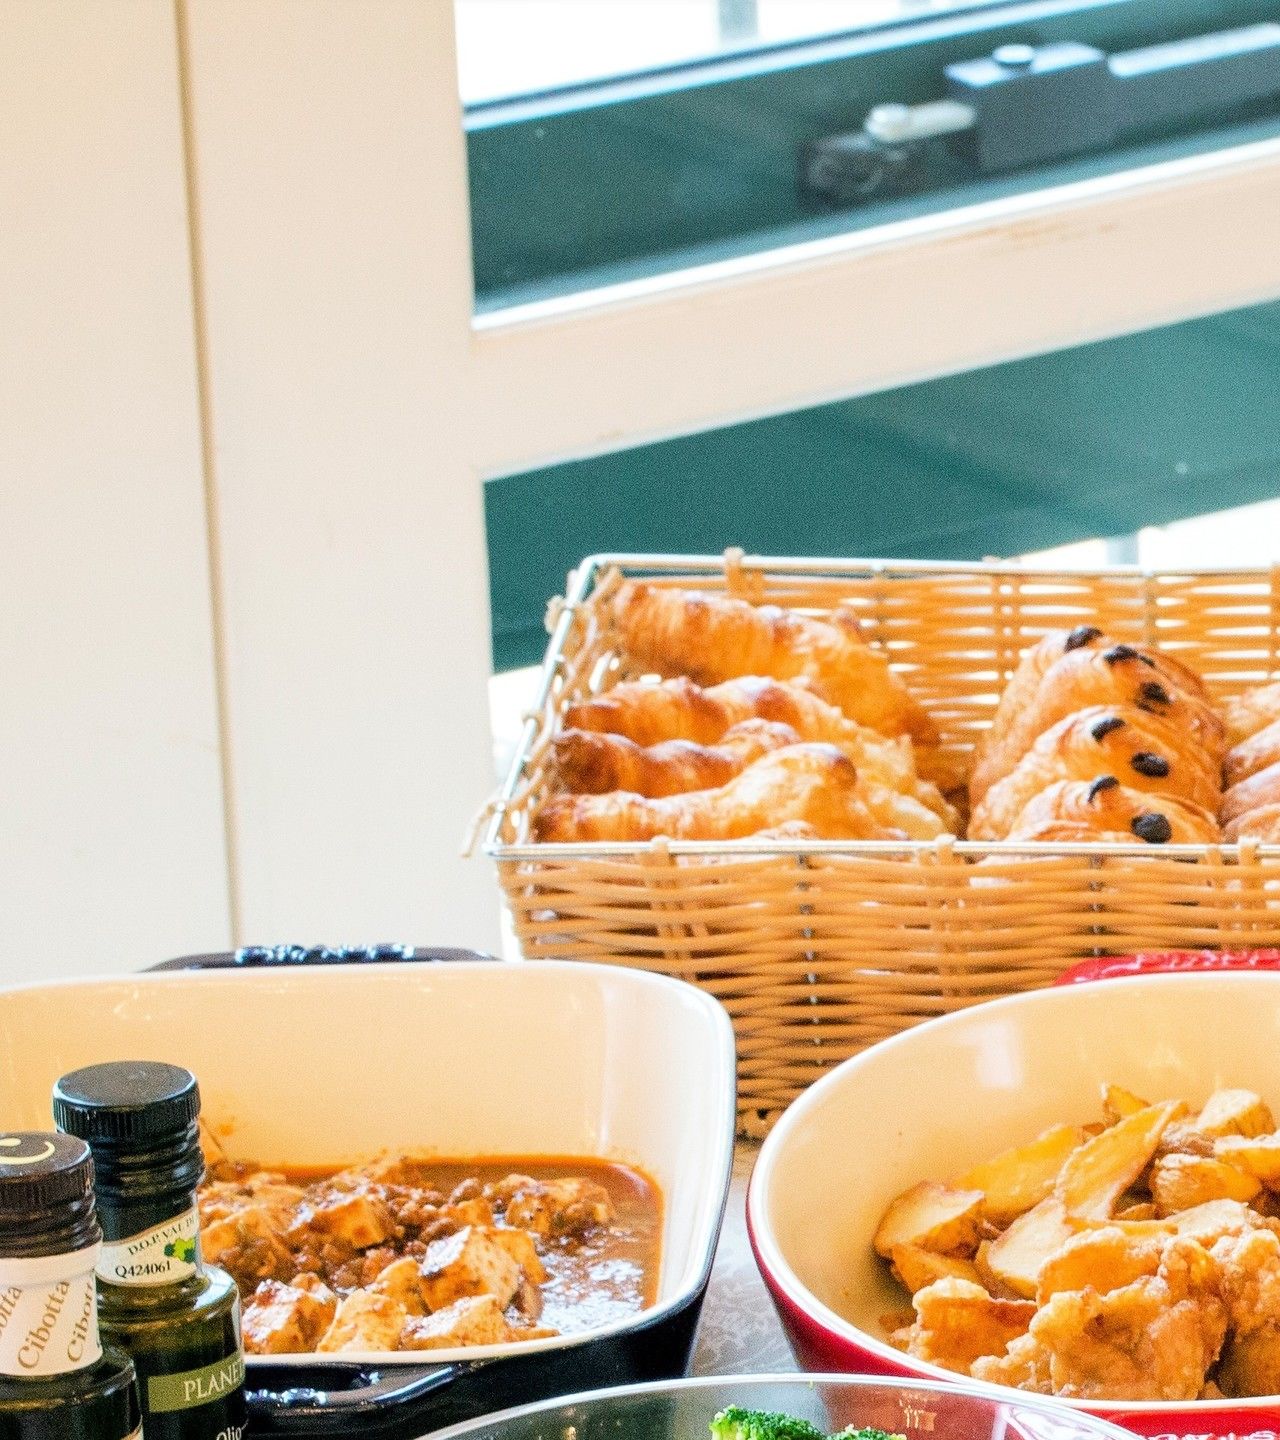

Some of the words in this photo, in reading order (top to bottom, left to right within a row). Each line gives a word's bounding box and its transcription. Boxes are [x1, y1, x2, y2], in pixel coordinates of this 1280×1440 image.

[115, 1260, 172, 1279] Q424061
[18, 1280, 70, 1369] Cibotta
[67, 1282, 93, 1362] Cibott
